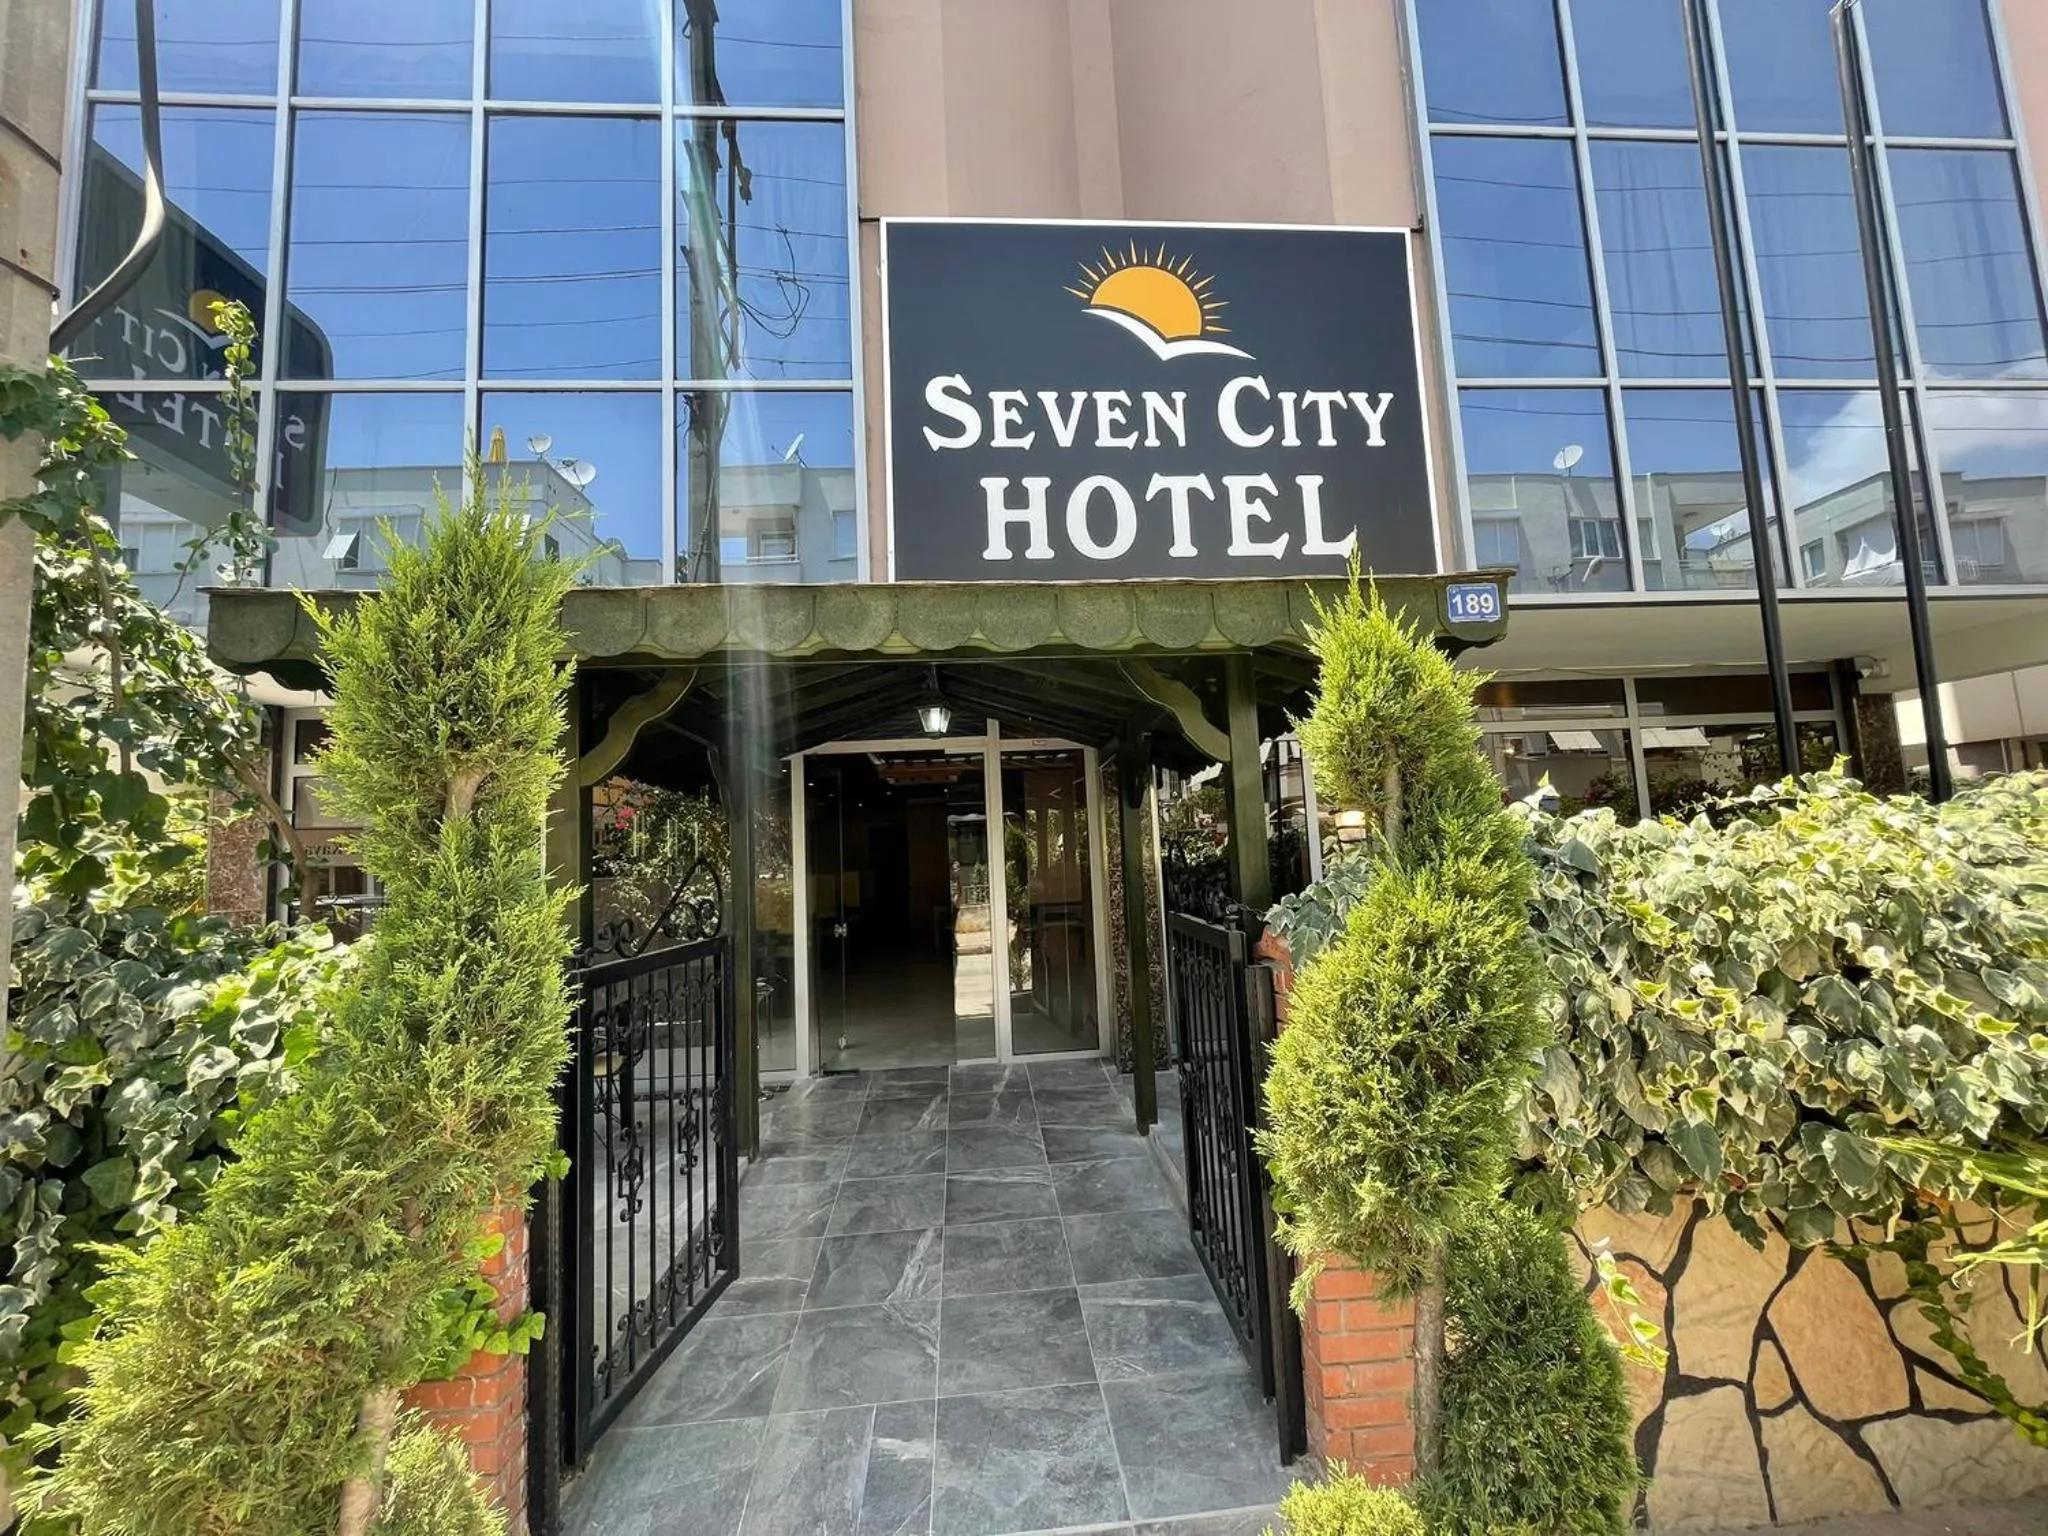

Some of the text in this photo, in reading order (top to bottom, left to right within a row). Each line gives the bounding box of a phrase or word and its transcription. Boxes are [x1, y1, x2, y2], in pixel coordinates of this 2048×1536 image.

[922, 373, 1395, 451] SEVEN CITY
[979, 471, 1358, 561] HOTEL
[1452, 593, 1493, 614] 189
